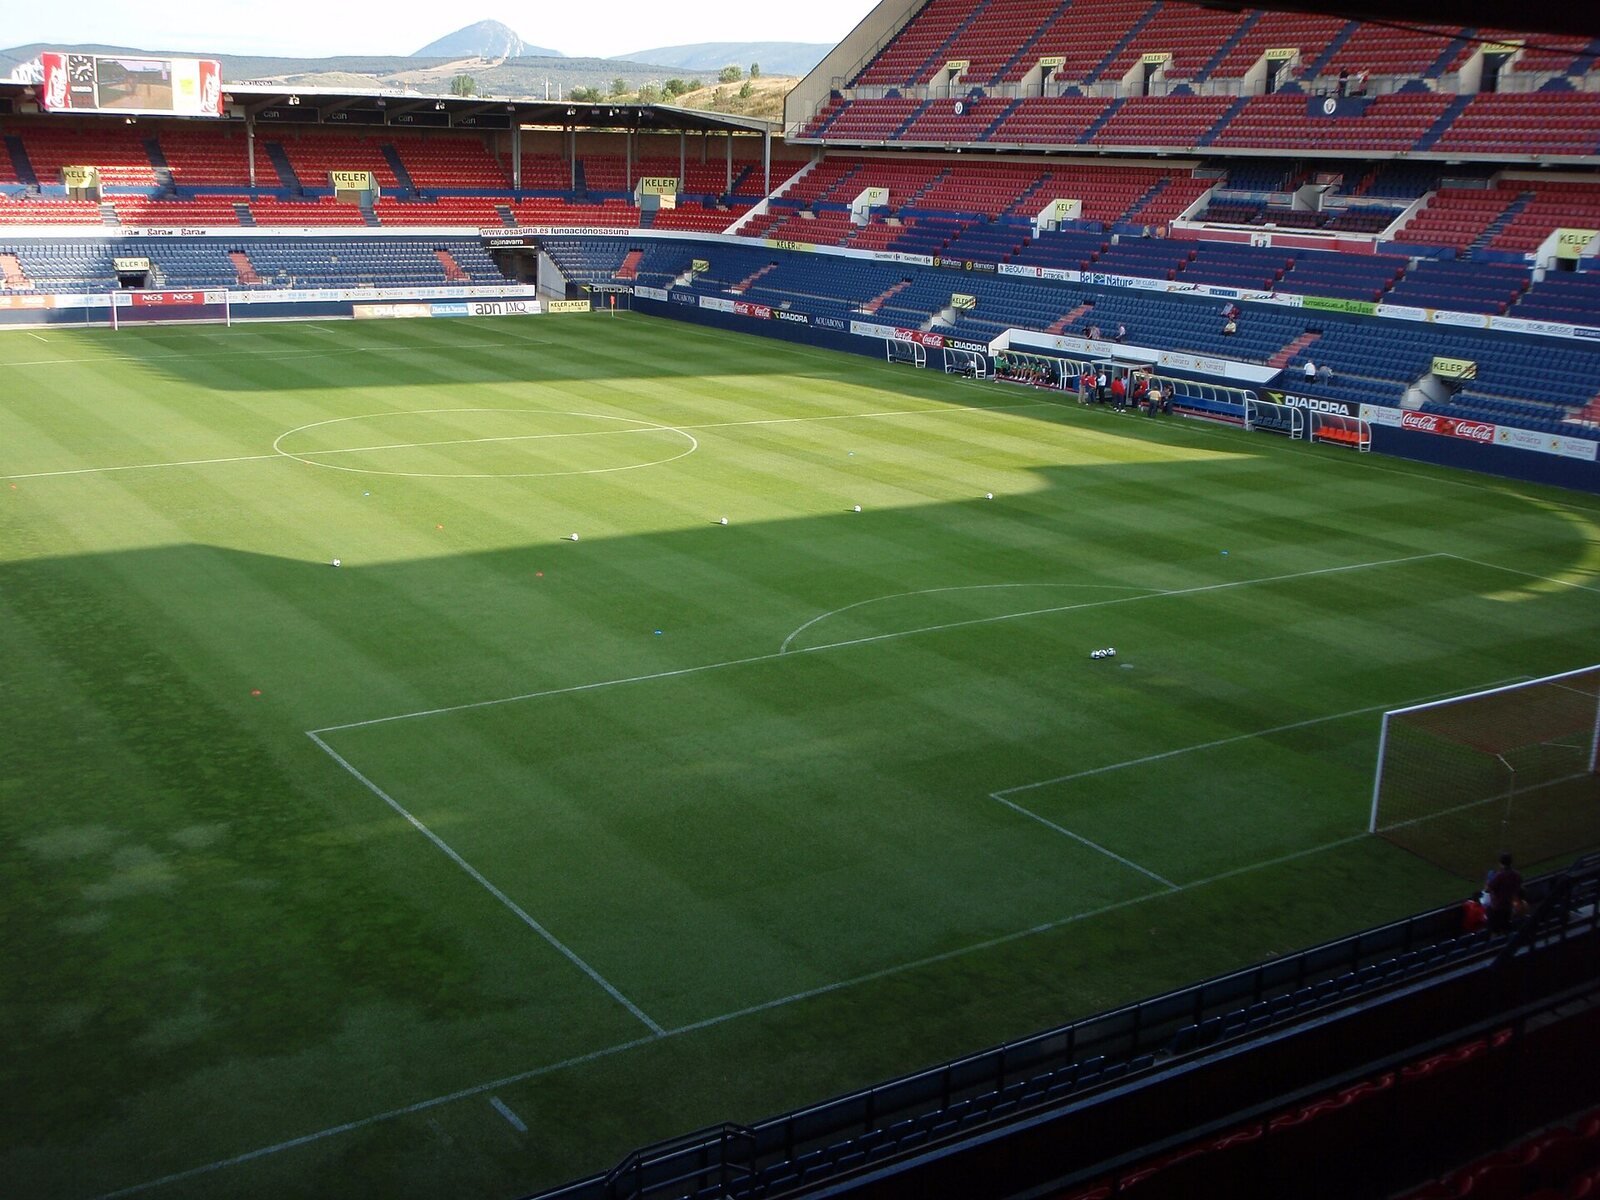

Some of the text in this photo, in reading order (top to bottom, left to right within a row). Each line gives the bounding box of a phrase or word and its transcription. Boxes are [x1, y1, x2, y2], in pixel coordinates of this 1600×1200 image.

[334, 173, 367, 181] KELER
[645, 179, 675, 187] KELER
[481, 227, 549, 236] www.osasuna.es
[776, 239, 796, 250] KELER
[1106, 275, 1134, 287] Nature
[592, 286, 634, 294] DIADORA
[475, 303, 502, 315] adn
[780, 311, 808, 324] DIADORA
[815, 316, 845, 329] AQUABONA
[954, 341, 988, 354] DIADORA
[1434, 361, 1462, 373] KELER
[1285, 395, 1350, 416] DIADORA
